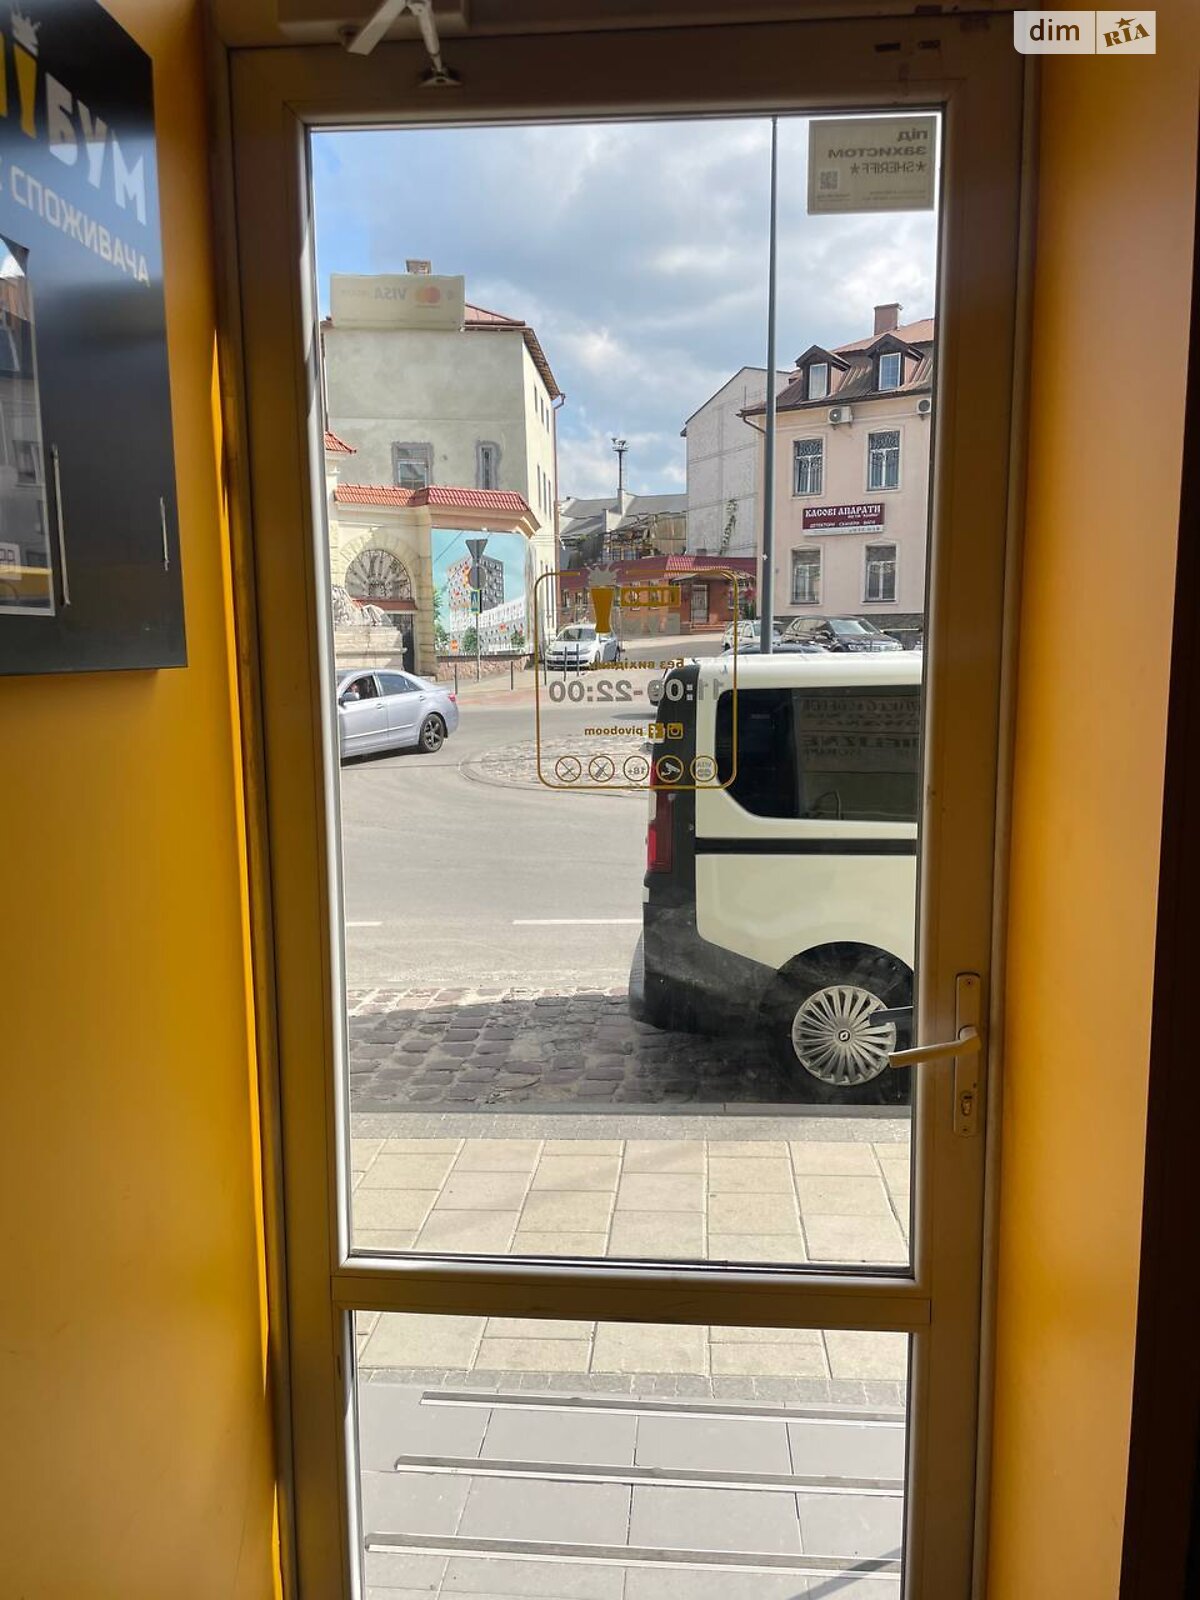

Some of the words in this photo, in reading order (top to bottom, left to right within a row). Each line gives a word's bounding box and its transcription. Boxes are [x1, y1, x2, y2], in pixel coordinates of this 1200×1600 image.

[45, 71, 148, 226] БУМ
[10, 165, 151, 288] СПОЖИВАЧА
[838, 504, 881, 516] АПАРАТИ
